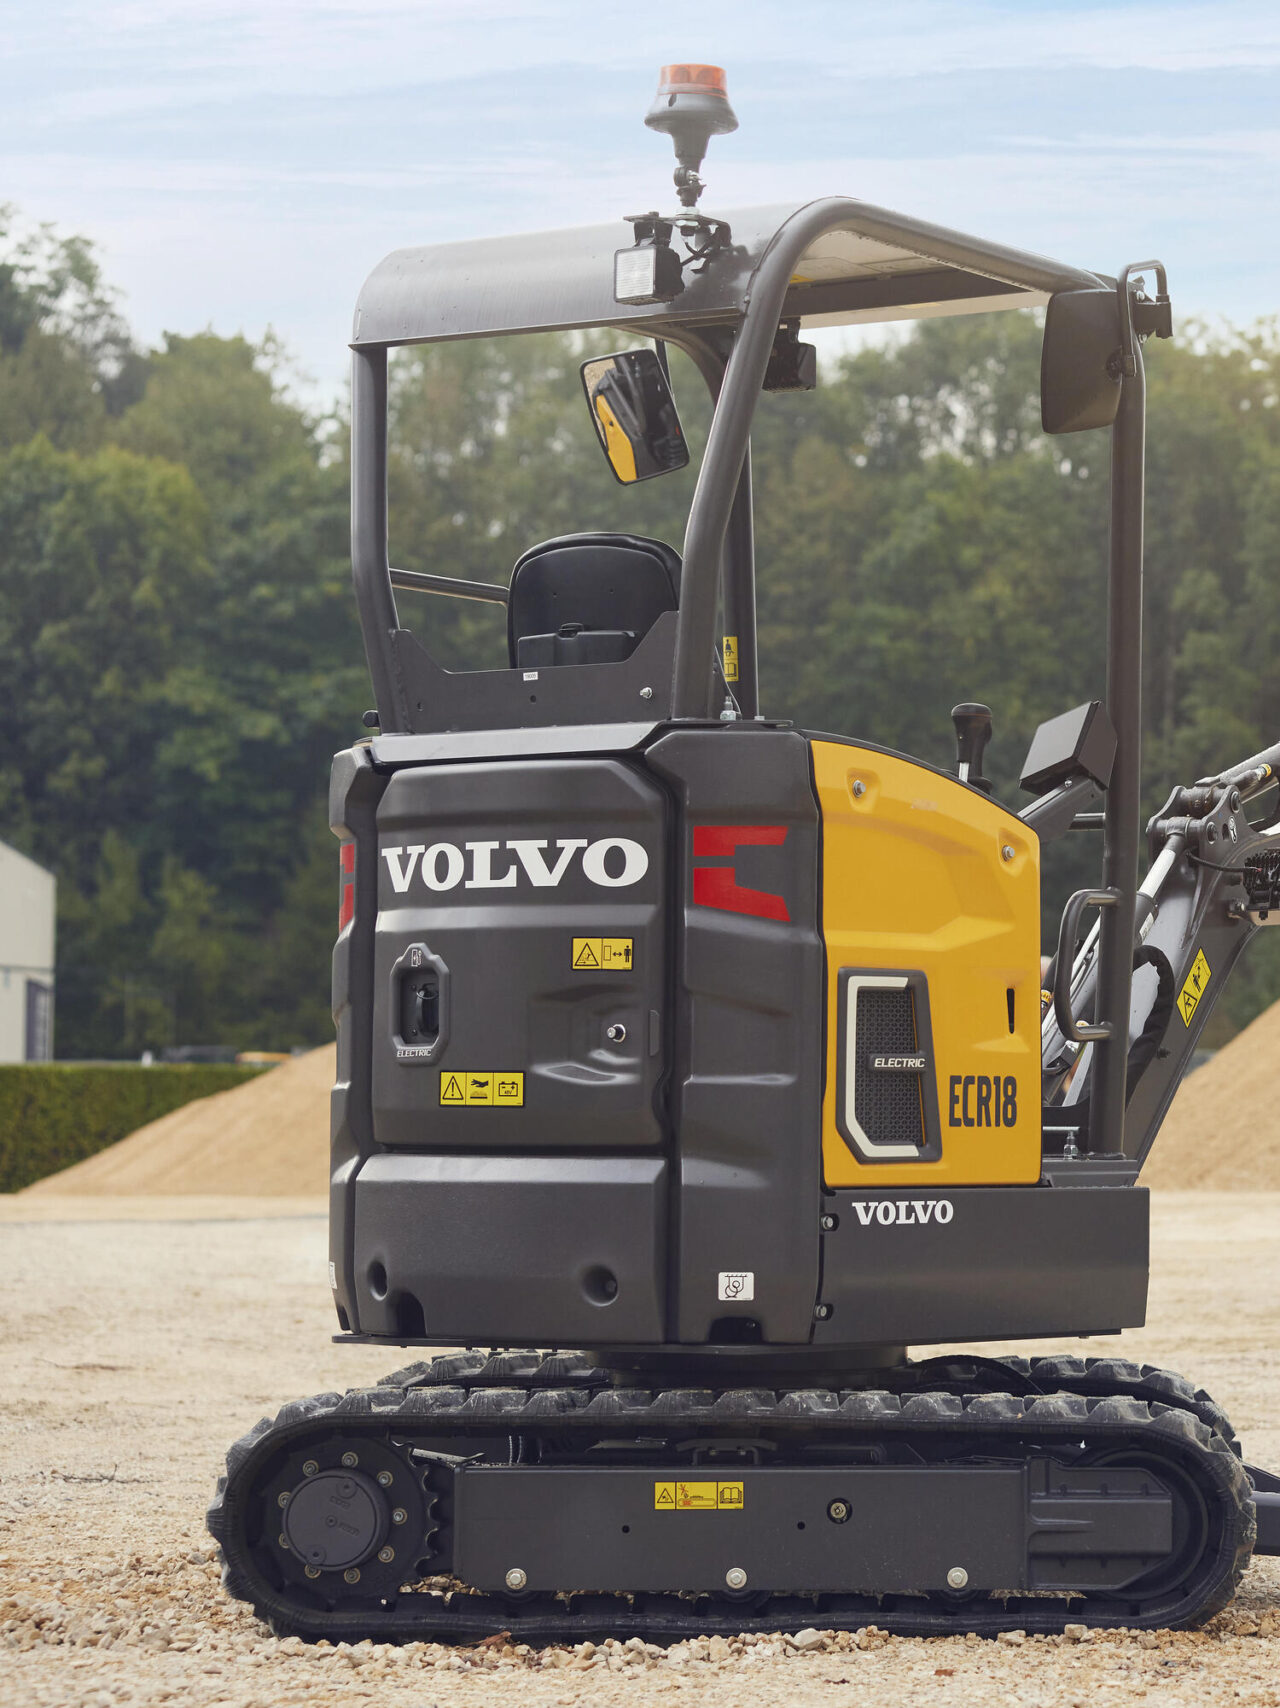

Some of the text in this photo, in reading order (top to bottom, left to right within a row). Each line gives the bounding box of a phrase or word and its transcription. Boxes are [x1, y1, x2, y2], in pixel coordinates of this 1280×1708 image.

[381, 837, 649, 893] VOLVO
[396, 1049, 431, 1057] ELECTRIC
[874, 1057, 926, 1068] ELECTRIC
[948, 1075, 1017, 1128] ECR18
[851, 1200, 954, 1225] VOLVO
